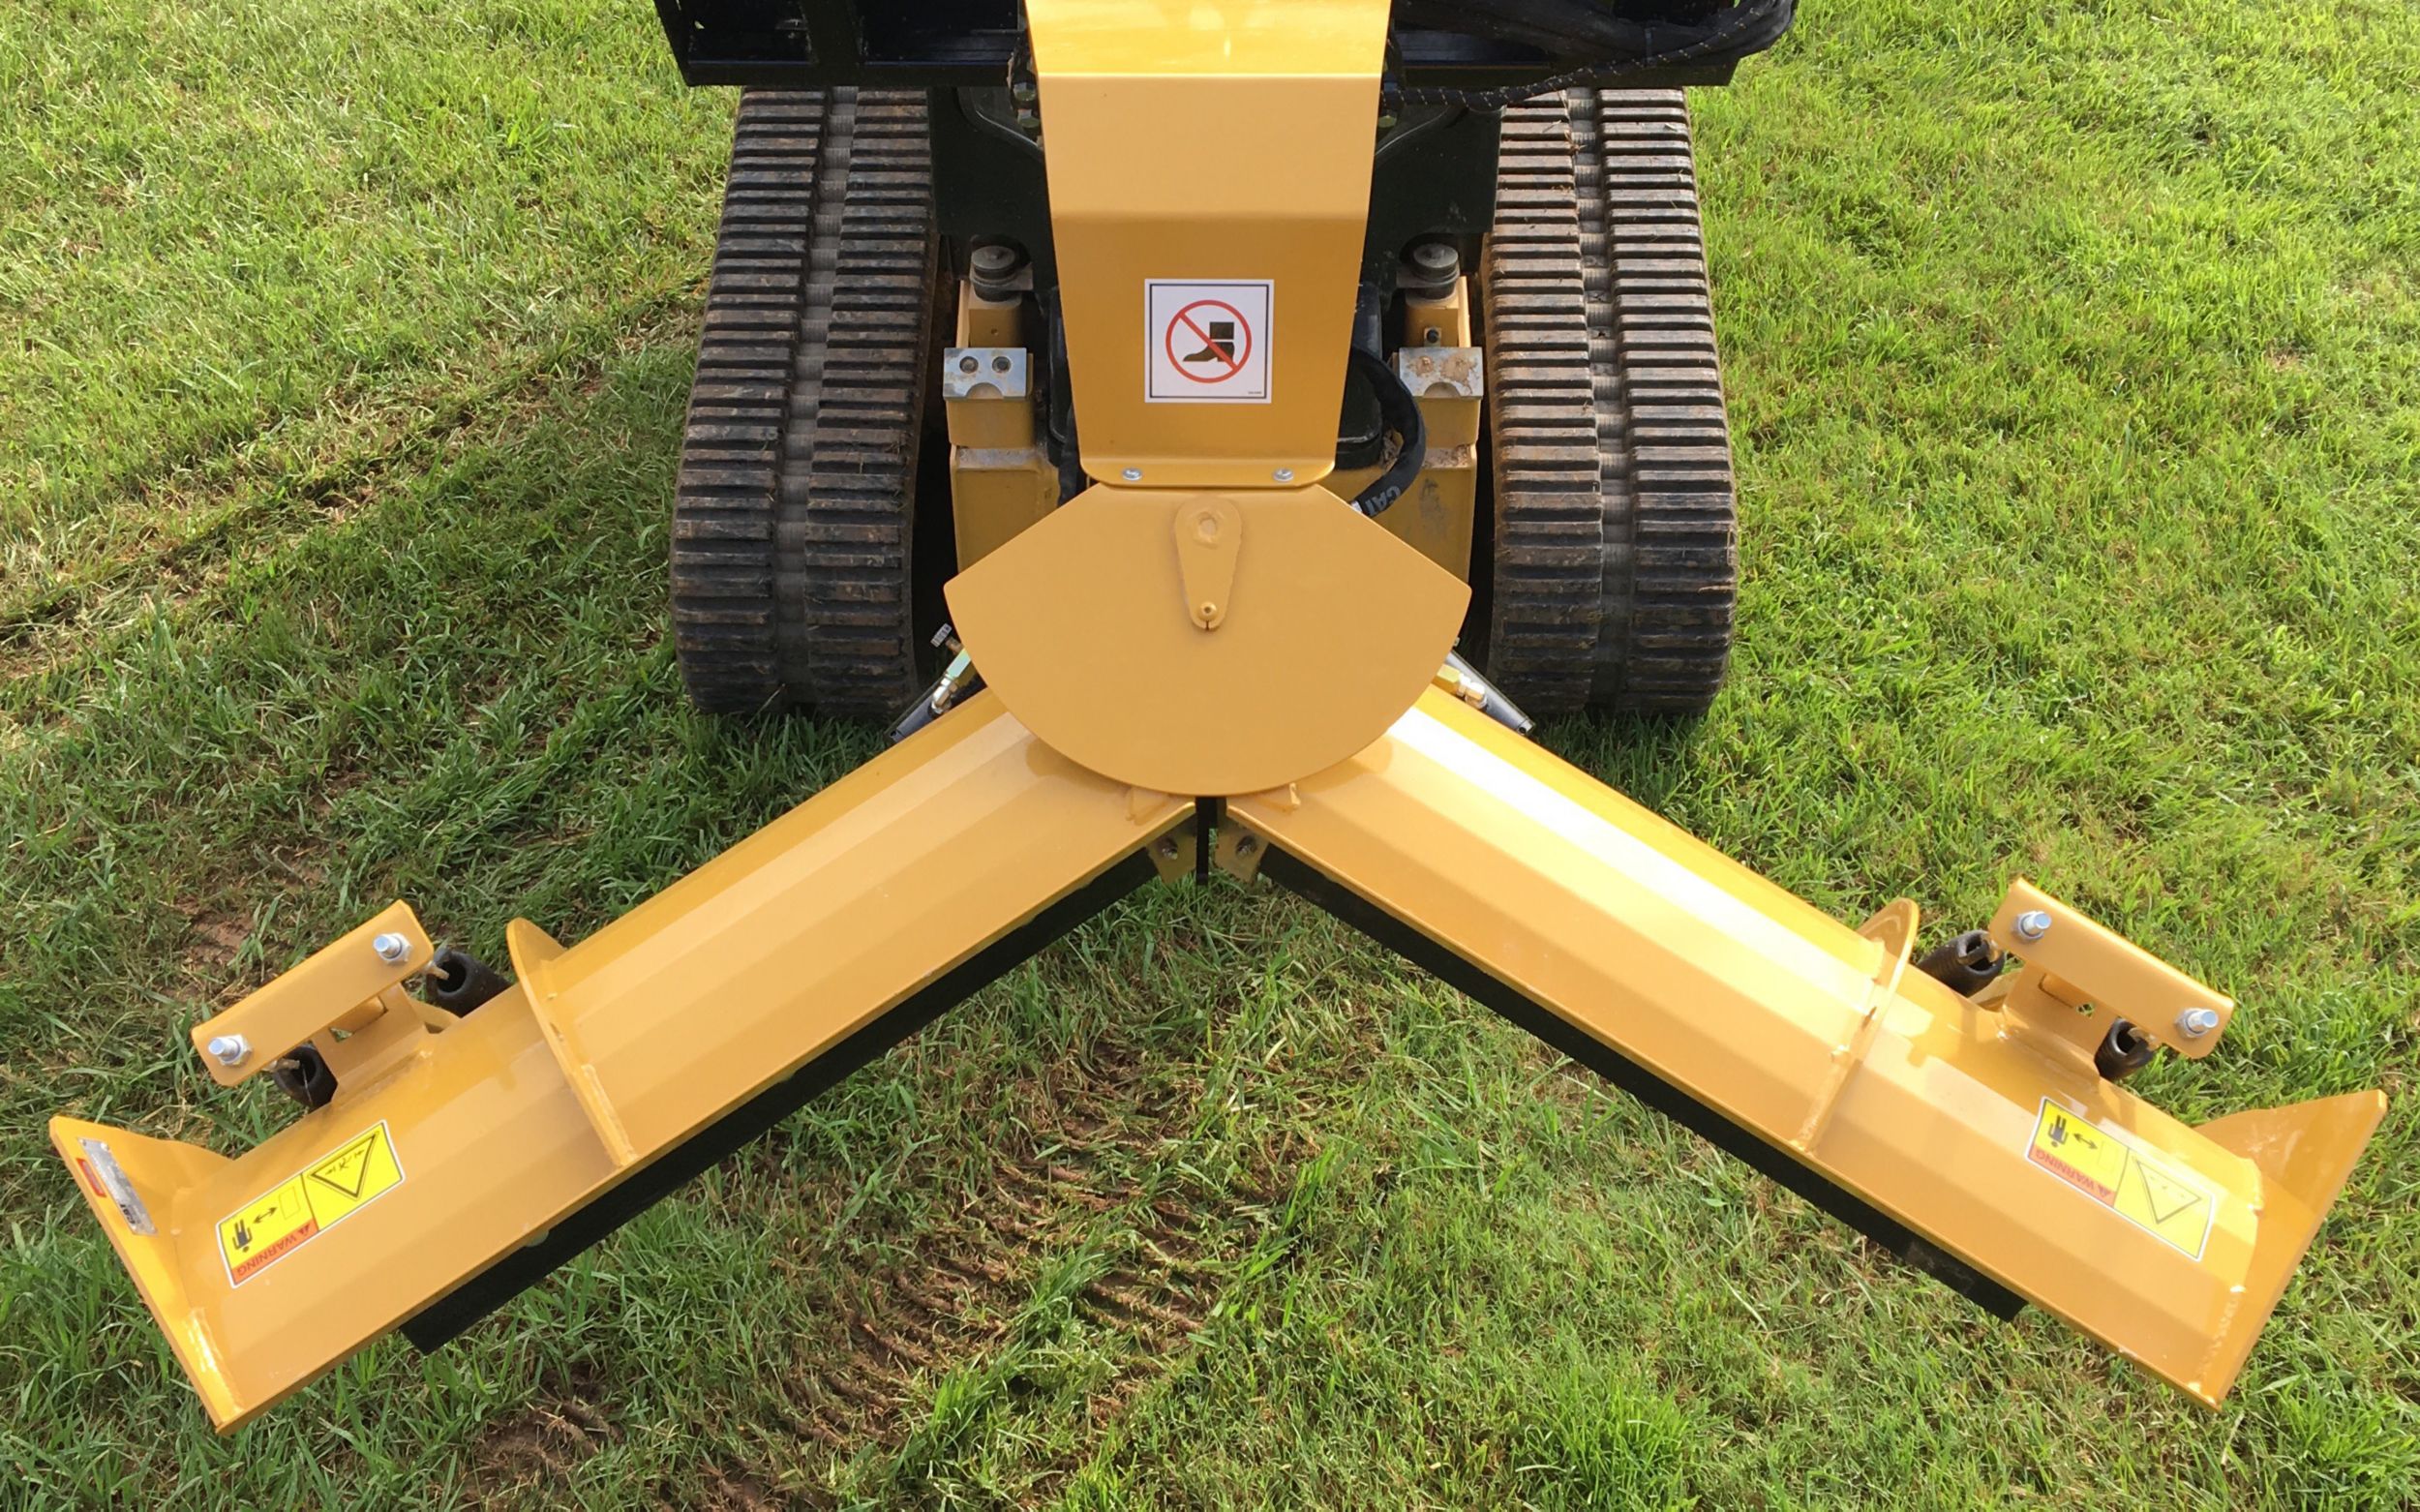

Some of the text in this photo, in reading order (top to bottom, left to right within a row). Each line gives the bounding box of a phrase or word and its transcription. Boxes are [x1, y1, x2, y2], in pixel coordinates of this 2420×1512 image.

[1364, 486, 1401, 516] CAT
[2036, 1148, 2095, 1190] WARNING
[237, 1234, 296, 1276] WARNING
